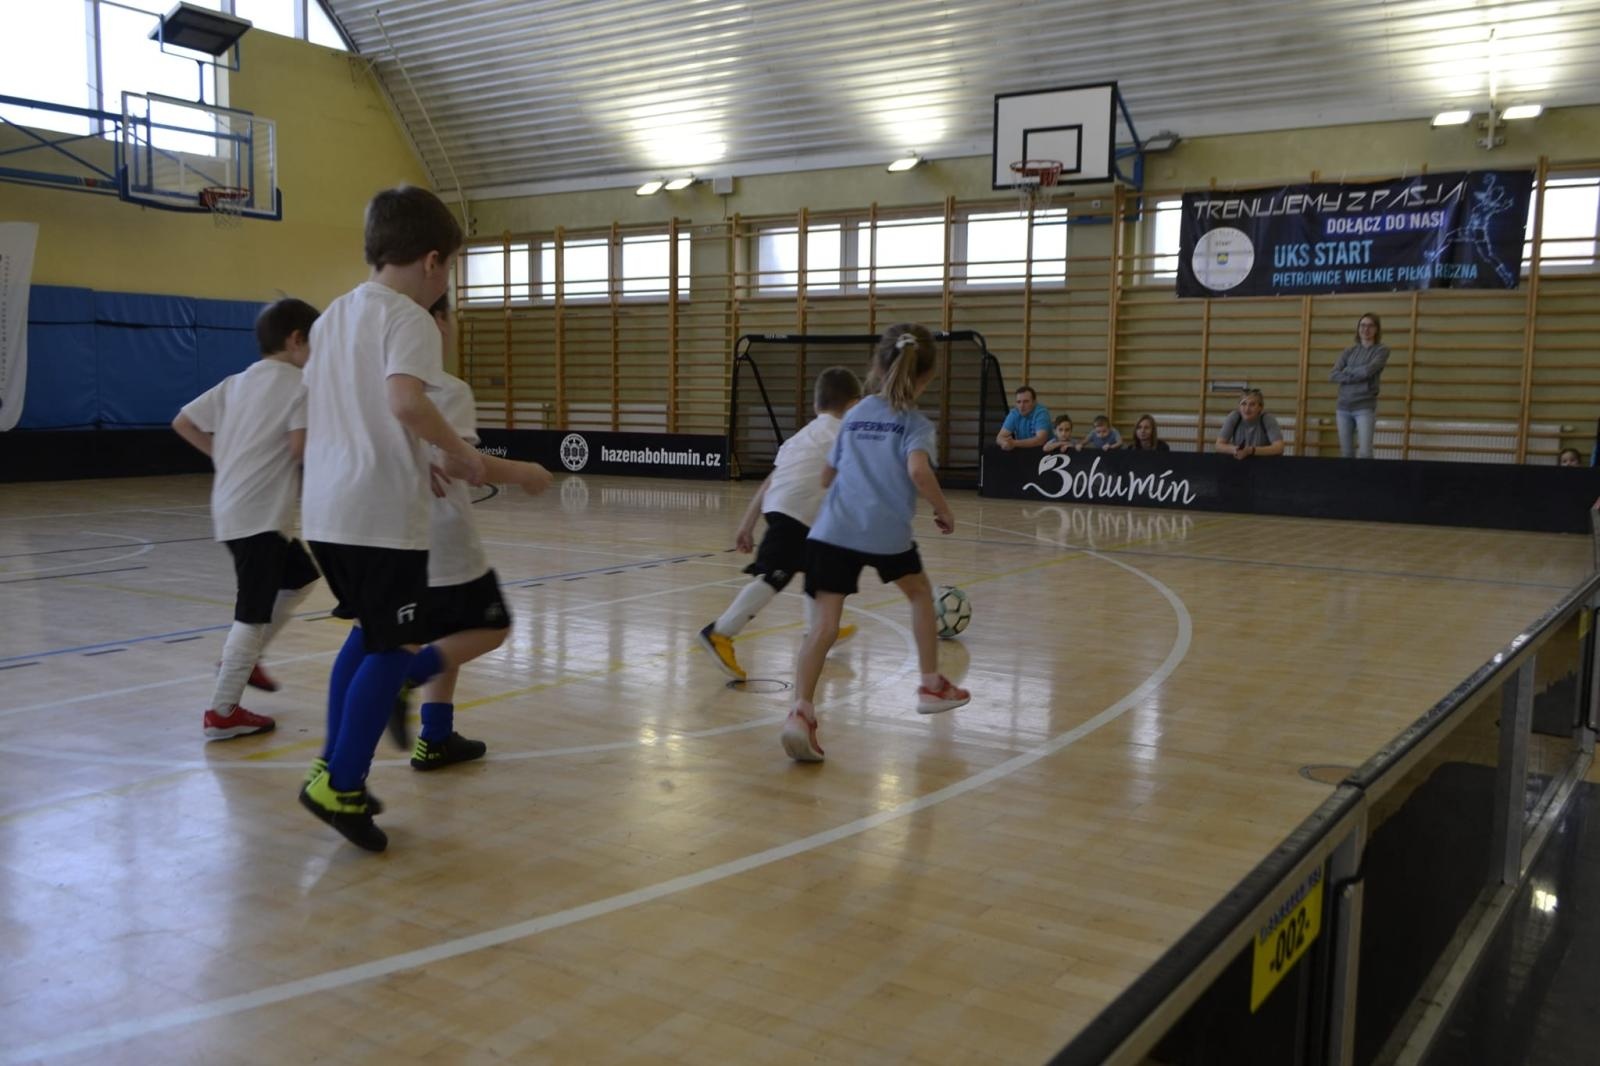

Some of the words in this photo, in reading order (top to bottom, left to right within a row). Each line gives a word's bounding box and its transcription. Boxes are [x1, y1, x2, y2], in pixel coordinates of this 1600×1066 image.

[1194, 192, 1343, 220] TRENUJEMY
[1346, 191, 1366, 211] Z
[1327, 216, 1382, 235] DOŁĄCZ
[1385, 214, 1405, 230] DO
[1410, 210, 1445, 229] NAS!
[1274, 243, 1310, 268] UKS
[1314, 240, 1373, 266] START
[1272, 270, 1341, 288] PIETROWICE
[1344, 267, 1394, 284] WIELKIE
[601, 445, 721, 467] hazenabohumin.cz
[1022, 453, 1196, 505] Bohumín
